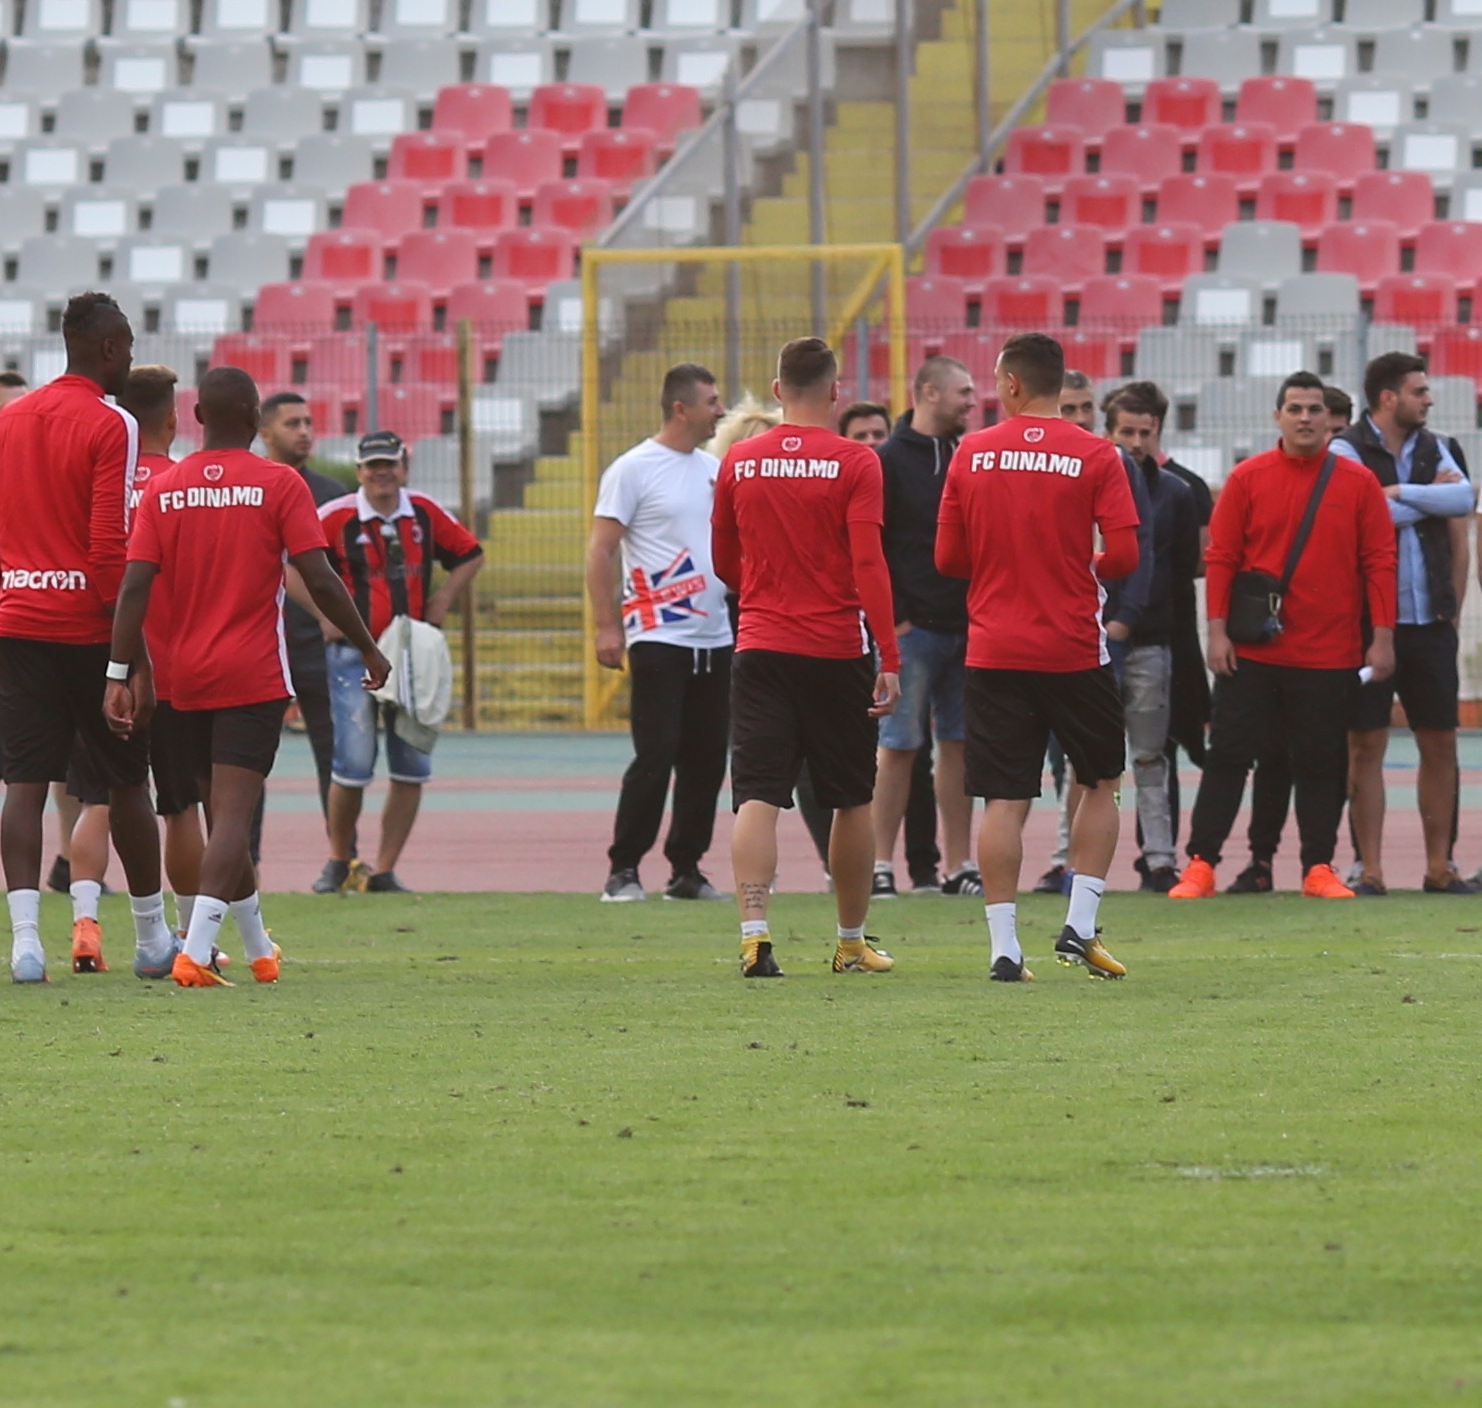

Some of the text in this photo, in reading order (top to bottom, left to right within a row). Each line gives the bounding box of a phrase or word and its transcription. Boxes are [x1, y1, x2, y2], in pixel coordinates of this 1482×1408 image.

[734, 458, 840, 482] FC DINAMO
[971, 450, 1083, 478] FC DINAMO
[159, 490, 184, 513] FC
[187, 486, 263, 508] DINAMO
[1, 569, 86, 590] macron
